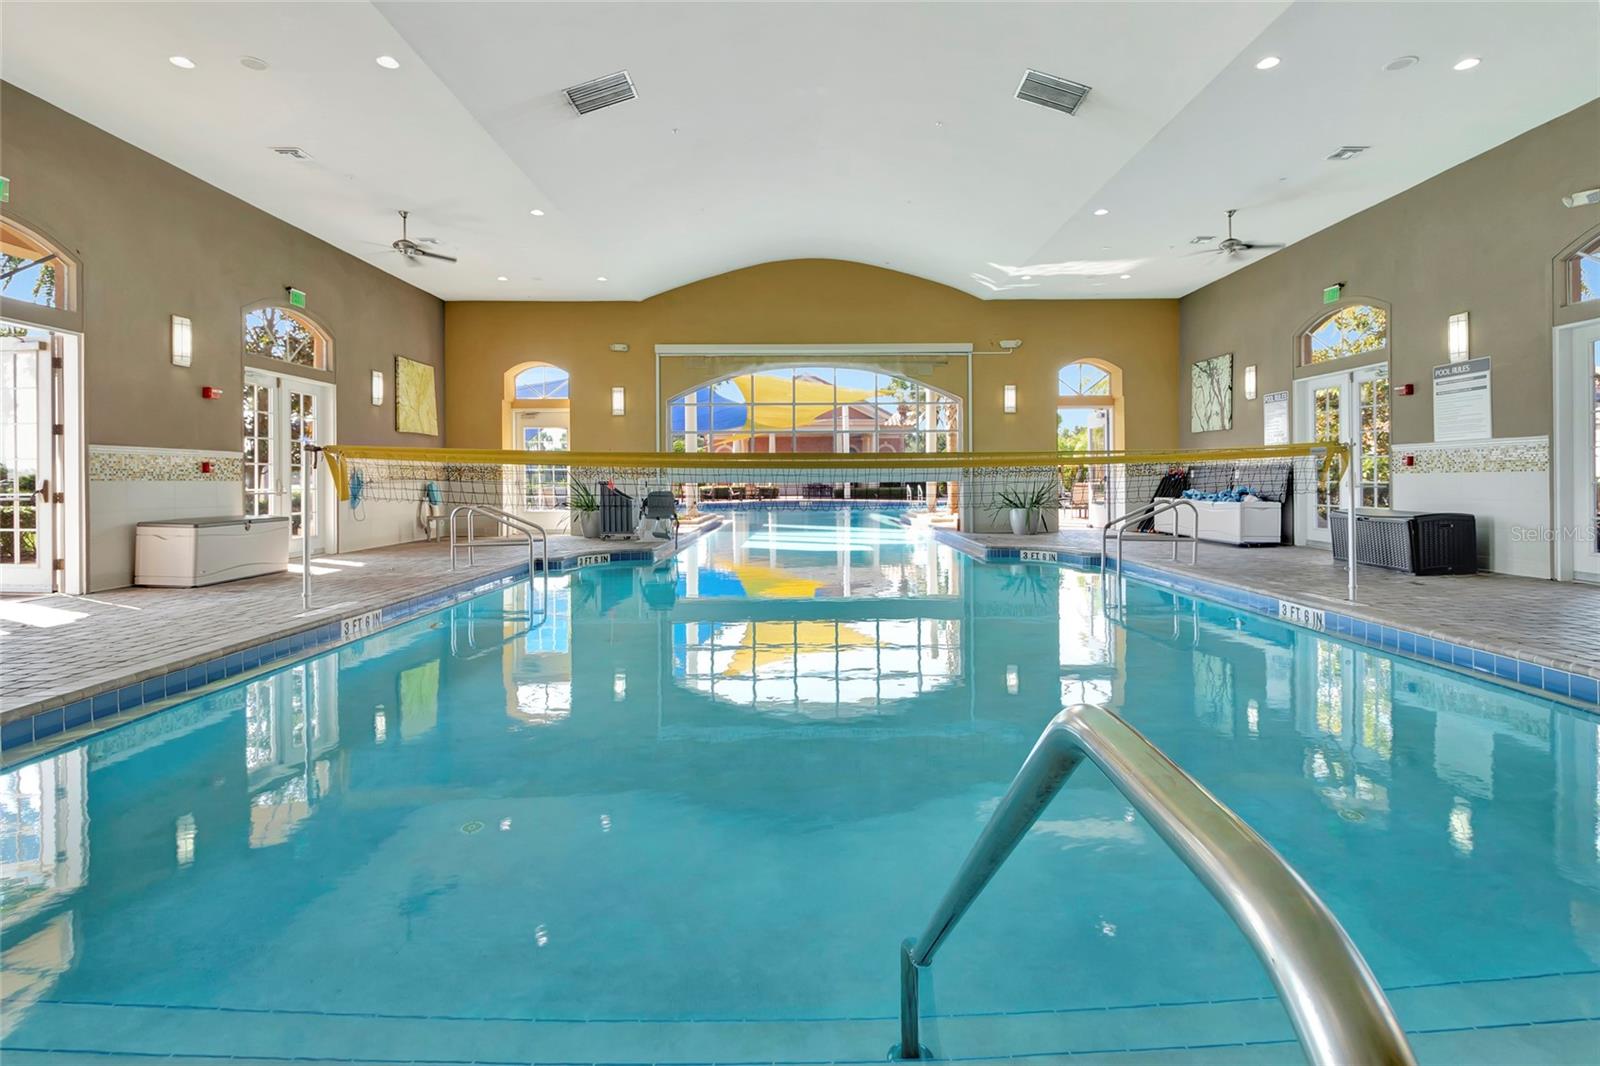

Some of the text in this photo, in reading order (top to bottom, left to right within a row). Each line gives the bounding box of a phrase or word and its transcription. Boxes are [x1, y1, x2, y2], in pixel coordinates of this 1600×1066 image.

[1435, 364, 1471, 377] POOL RULES
[585, 556, 592, 566] FT
[601, 555, 609, 563] IN
[1023, 551, 1028, 560] 3
[1031, 552, 1040, 560] FT
[1049, 553, 1057, 562] IN
[1282, 603, 1323, 628] 3 FT 6 IN
[344, 611, 381, 636] 3 FT 6 IN
